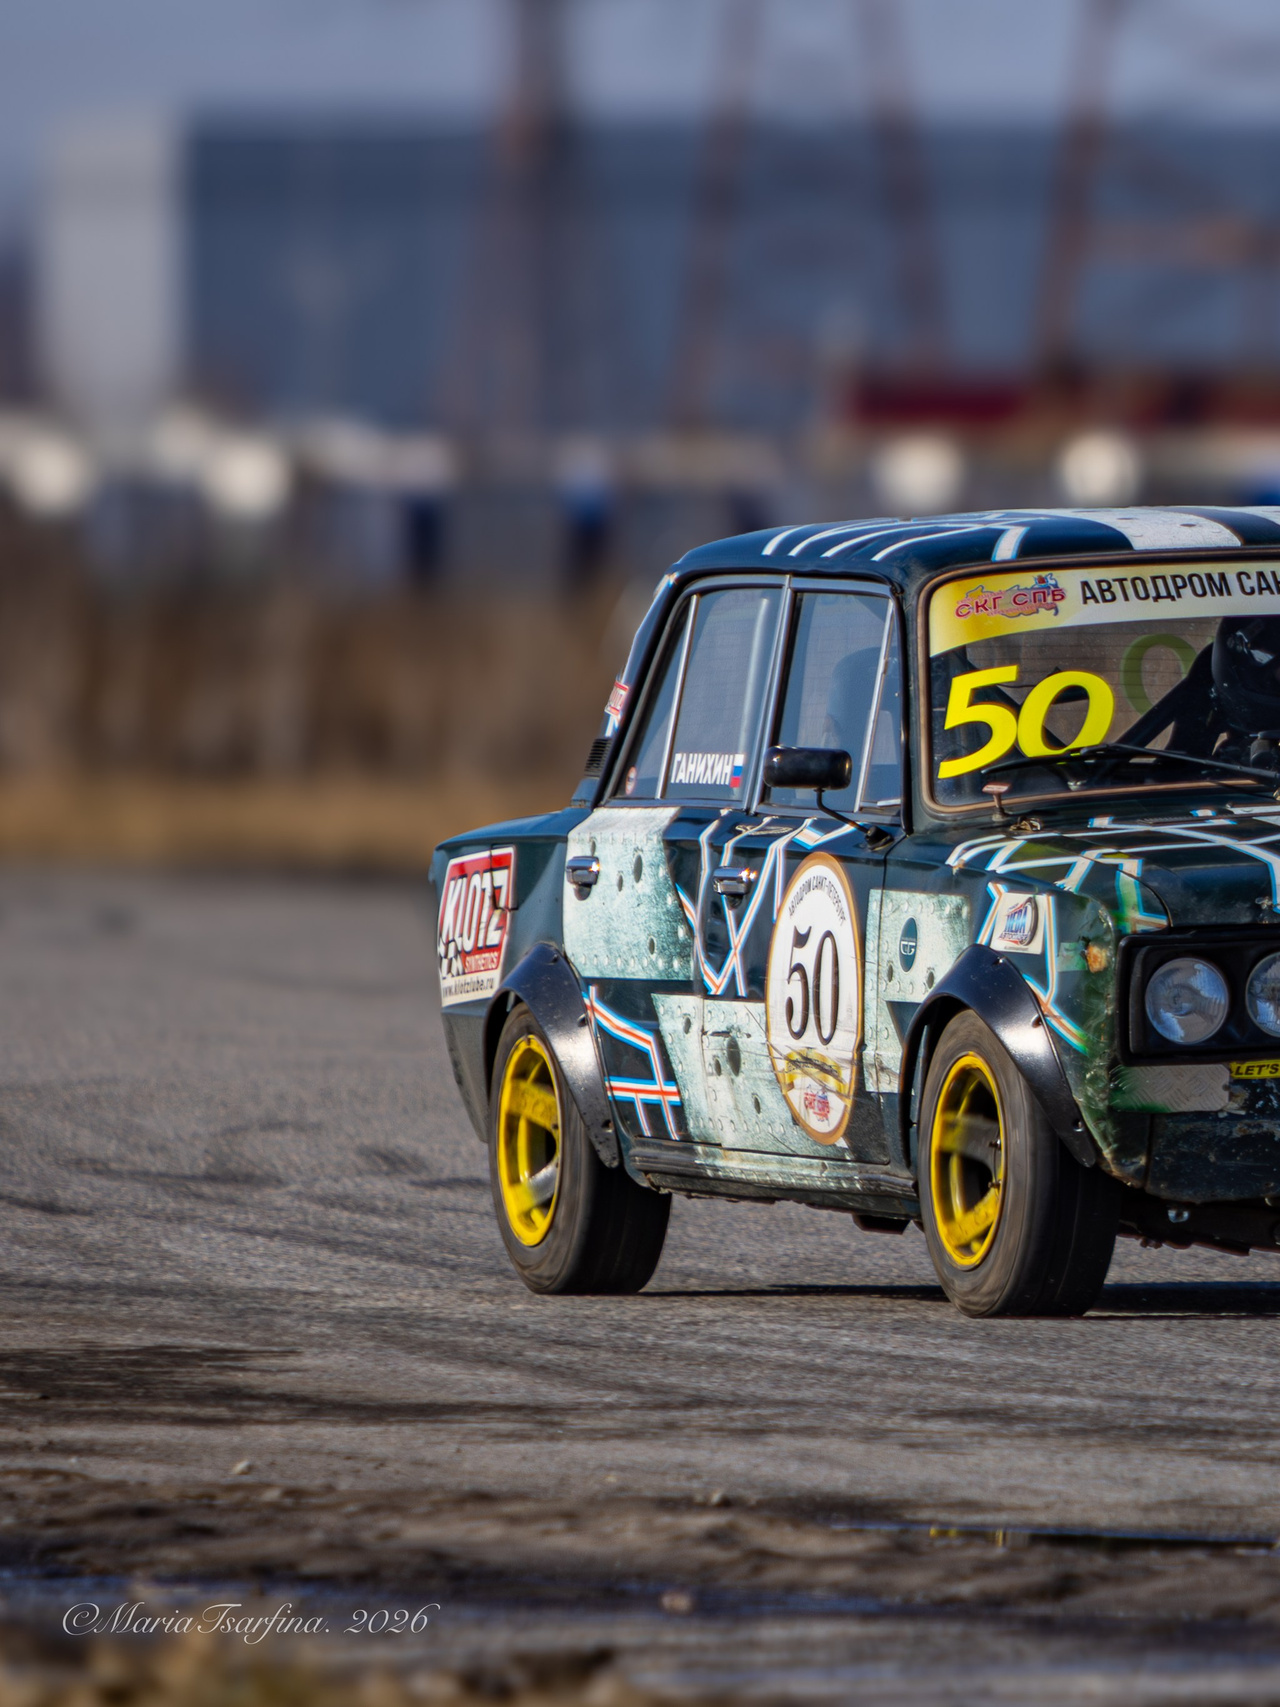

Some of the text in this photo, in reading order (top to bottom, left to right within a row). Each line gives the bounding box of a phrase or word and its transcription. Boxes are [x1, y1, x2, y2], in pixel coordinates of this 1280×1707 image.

[955, 589, 1066, 618] СКГ СПБ
[1080, 571, 1232, 605] АВТОДРОМ
[937, 665, 1114, 779] 50
[670, 752, 733, 785] ГАНИХИН
[441, 867, 509, 954] KLOTZ
[786, 925, 840, 1046] 50
[1234, 1063, 1280, 1076] LET'S
